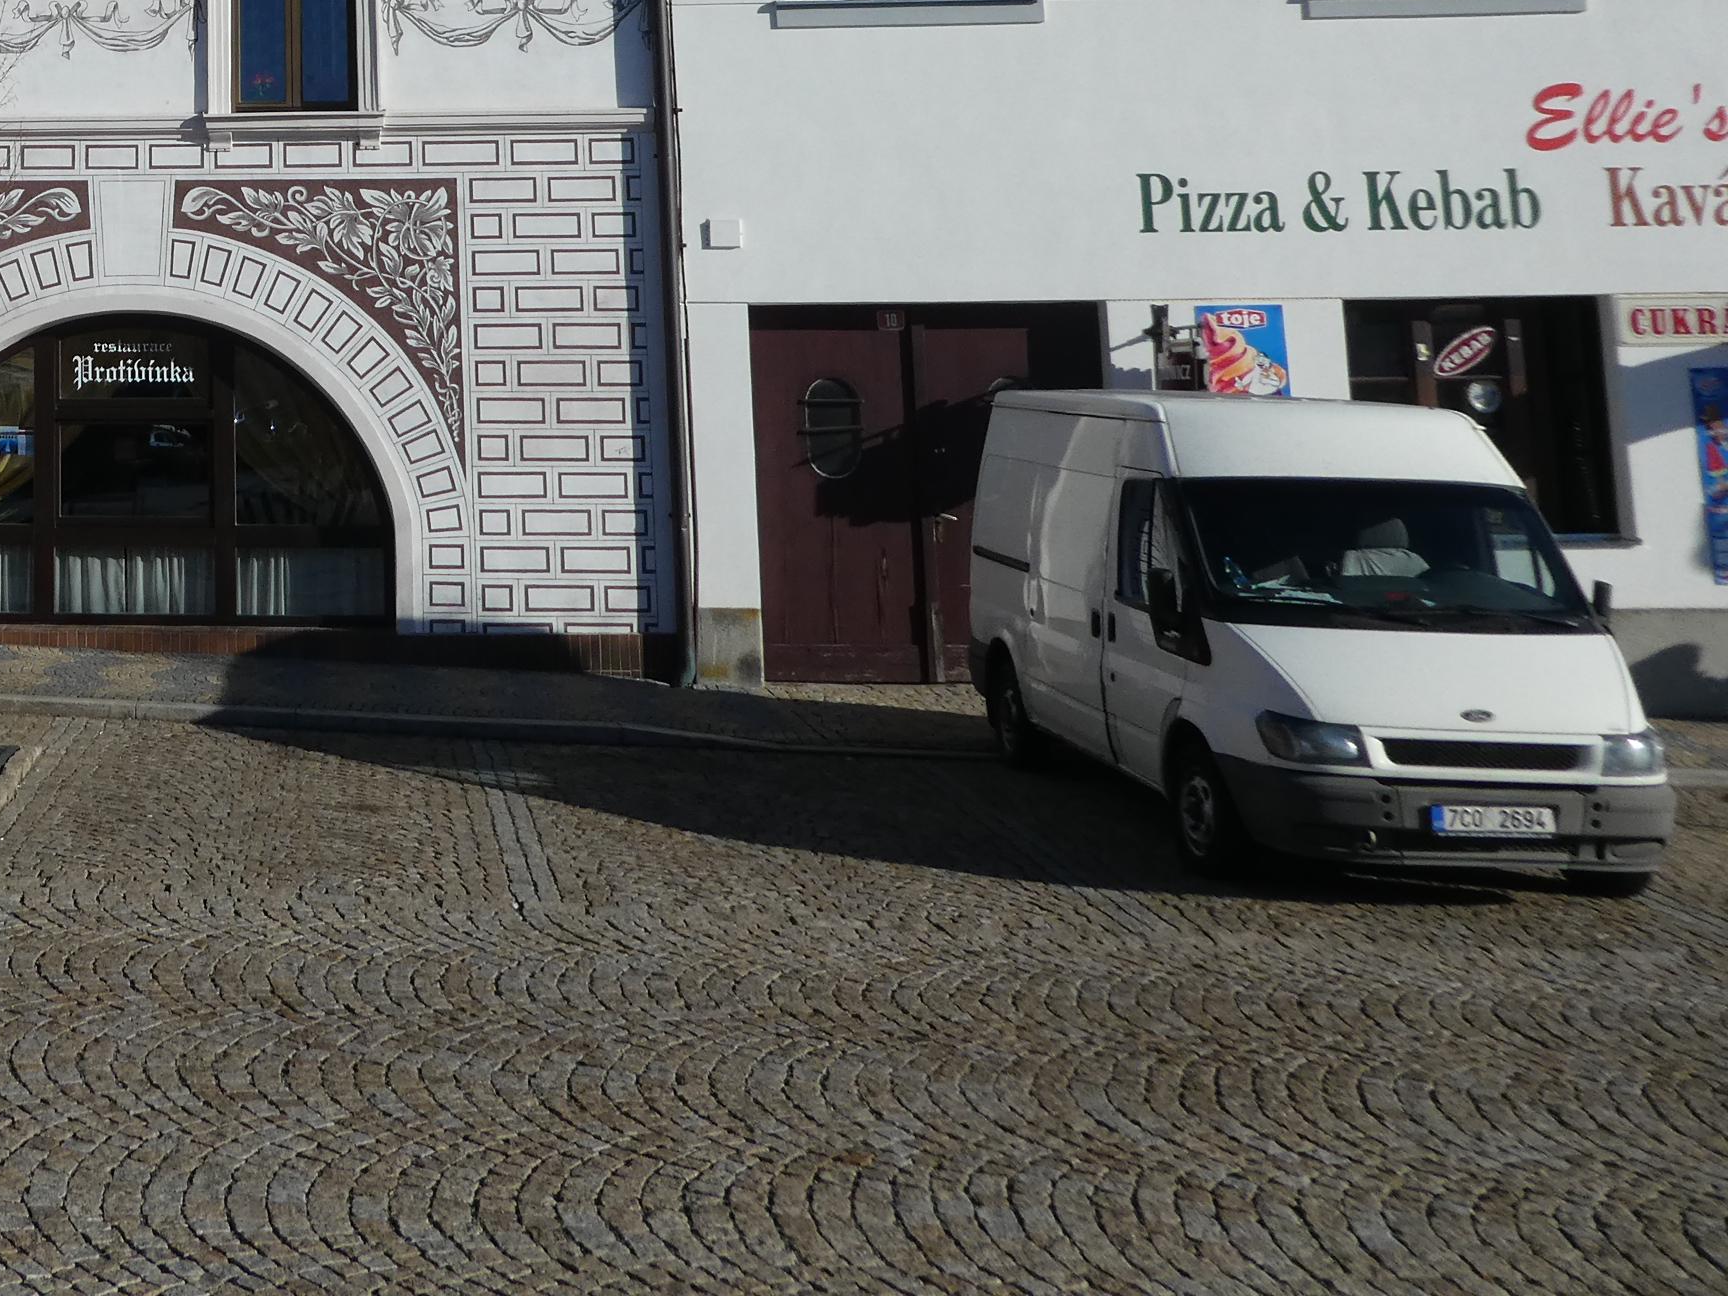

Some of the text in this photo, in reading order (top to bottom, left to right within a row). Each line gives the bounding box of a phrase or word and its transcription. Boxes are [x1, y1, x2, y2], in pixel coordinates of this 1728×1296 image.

[1526, 82, 1728, 151] Ellie's
[1136, 171, 1285, 233] Pizza
[1302, 170, 1349, 233] &
[1363, 167, 1542, 232] Kebab
[1221, 310, 1261, 328] toje
[1630, 307, 1728, 335] CUKR
[93, 339, 173, 353] restaurace
[1440, 332, 1492, 372] KEBAB
[72, 355, 195, 391] Protivínka
[1499, 808, 1547, 829] 2694
